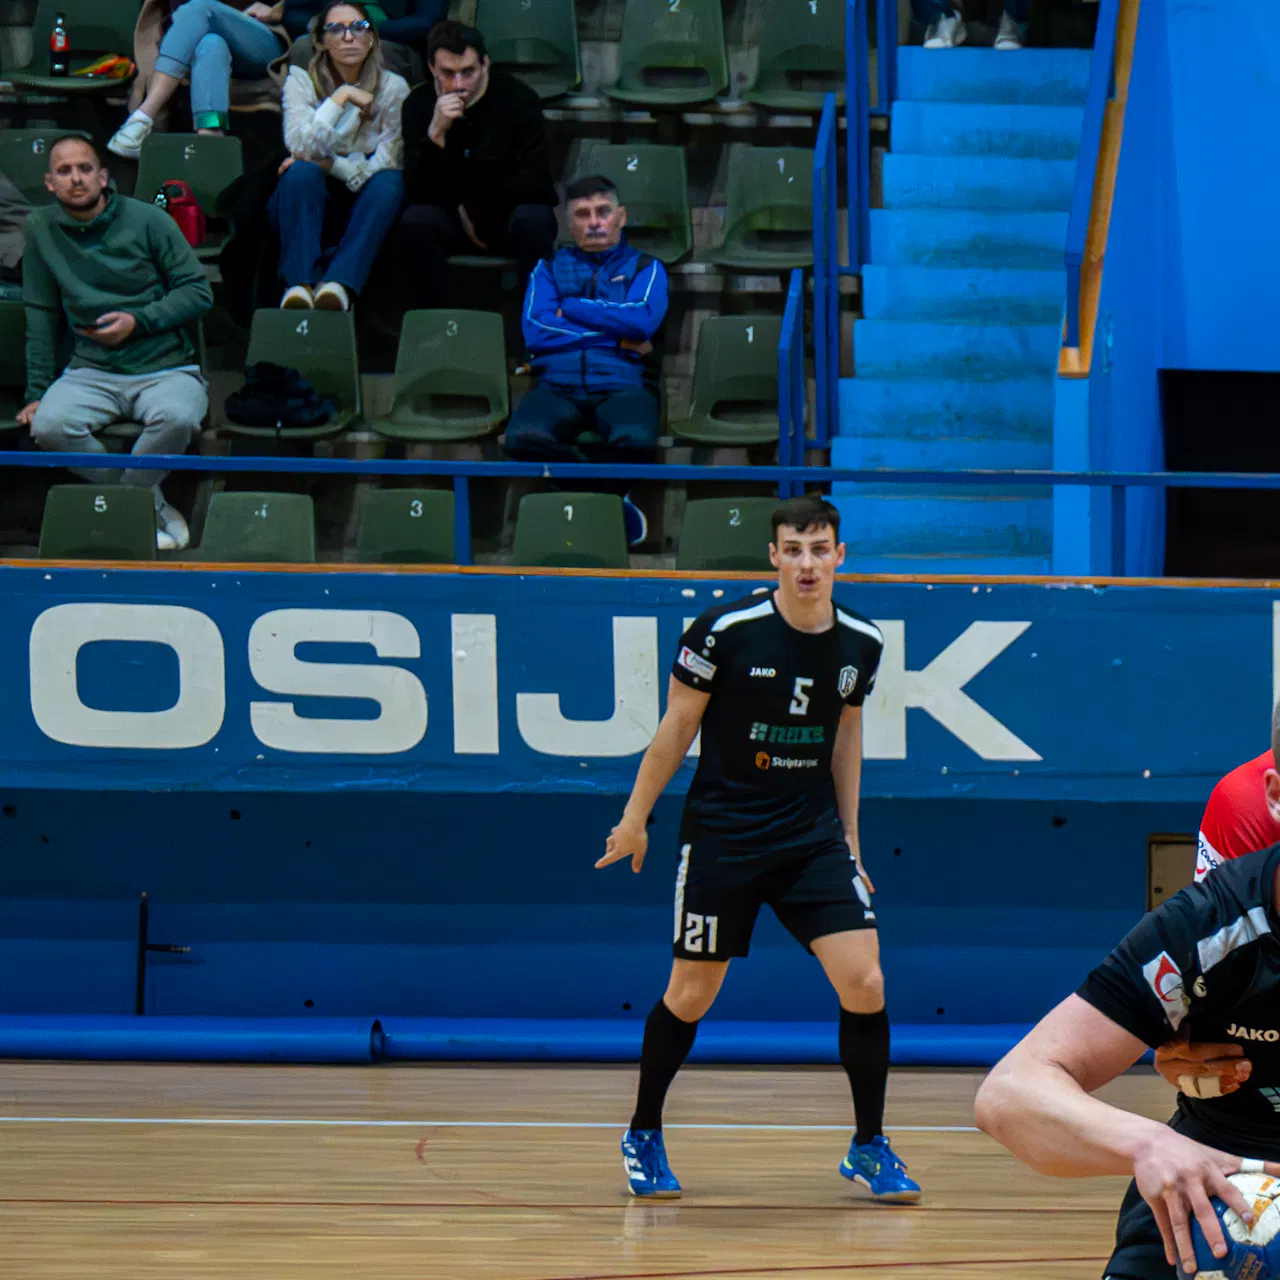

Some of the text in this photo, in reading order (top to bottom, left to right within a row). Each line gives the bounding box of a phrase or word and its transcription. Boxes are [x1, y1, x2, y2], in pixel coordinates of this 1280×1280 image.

[410, 500, 424, 518] 3
[728, 508, 743, 526] 2
[750, 666, 777, 678] JAKO
[28, 602, 1044, 763] OSIJK
[789, 676, 815, 716] 5
[683, 911, 718, 954] 21
[1226, 1023, 1280, 1043] JAKO
